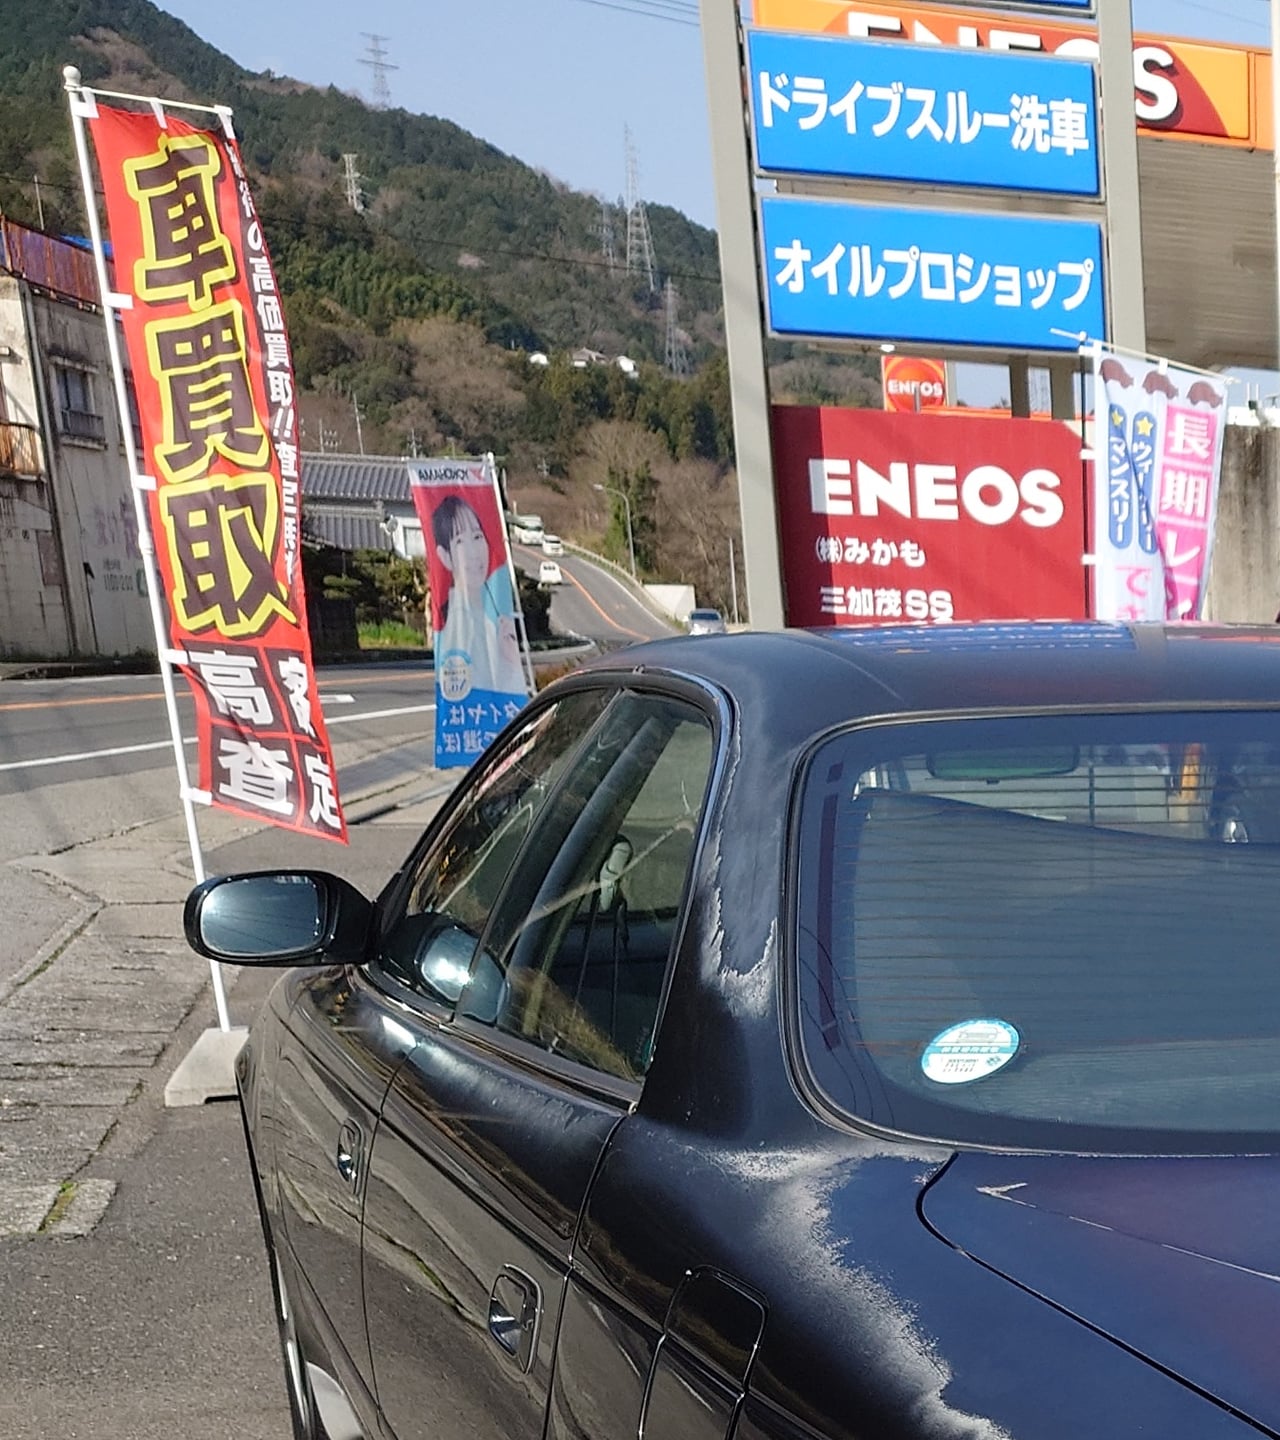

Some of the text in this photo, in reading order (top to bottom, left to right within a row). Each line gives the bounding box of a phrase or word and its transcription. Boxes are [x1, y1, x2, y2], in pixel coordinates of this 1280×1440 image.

[759, 70, 1089, 156] ドライブスルー洗車
[774, 238, 1096, 311] オイルプロショップ
[125, 135, 297, 637] 車買取
[808, 458, 1065, 528] ENEOS
[1110, 436, 1130, 542] マンスリー
[820, 586, 954, 620] 三加茂SS
